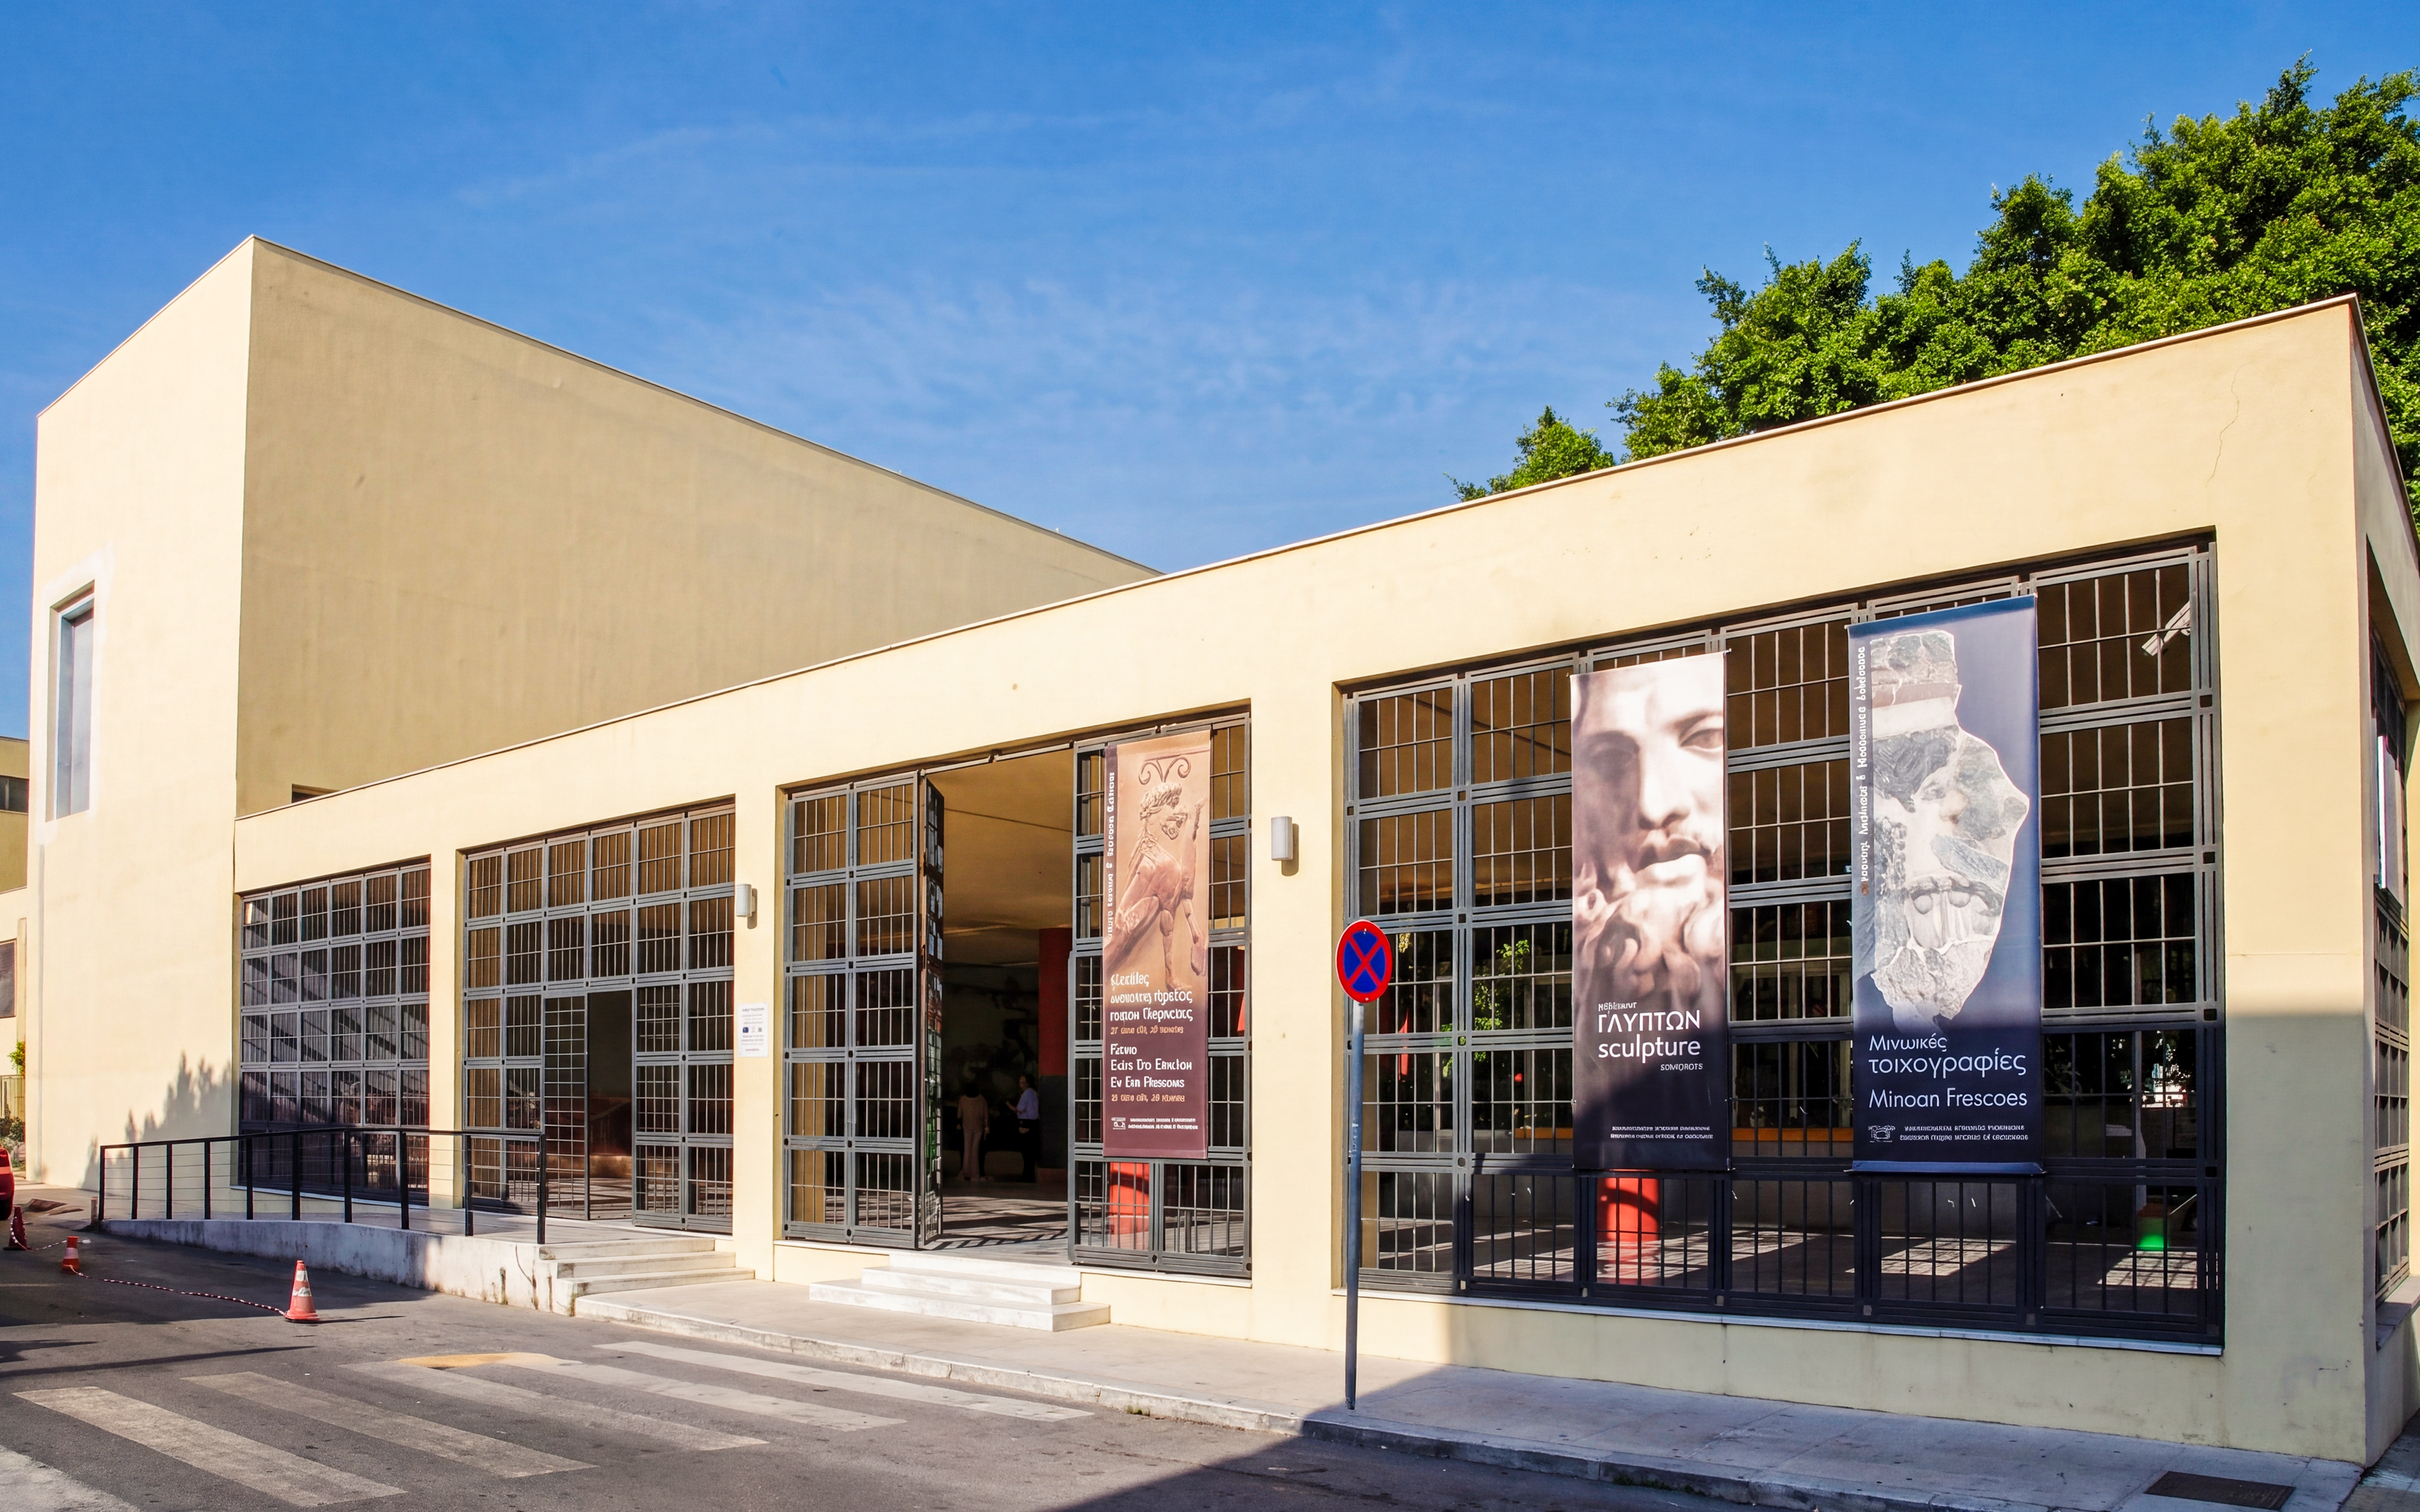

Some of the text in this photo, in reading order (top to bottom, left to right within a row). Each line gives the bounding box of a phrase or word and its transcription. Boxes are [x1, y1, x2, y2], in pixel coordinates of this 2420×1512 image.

[1599, 1010, 1700, 1033] ΓΛΥΠΤΩΝ
[1598, 1034, 1701, 1063] sculpture
[1869, 1033, 1947, 1052] Μινωικές
[1868, 1048, 2026, 1079] τοιχογραφίες
[1869, 1088, 2027, 1107] Minoan Frescoes
